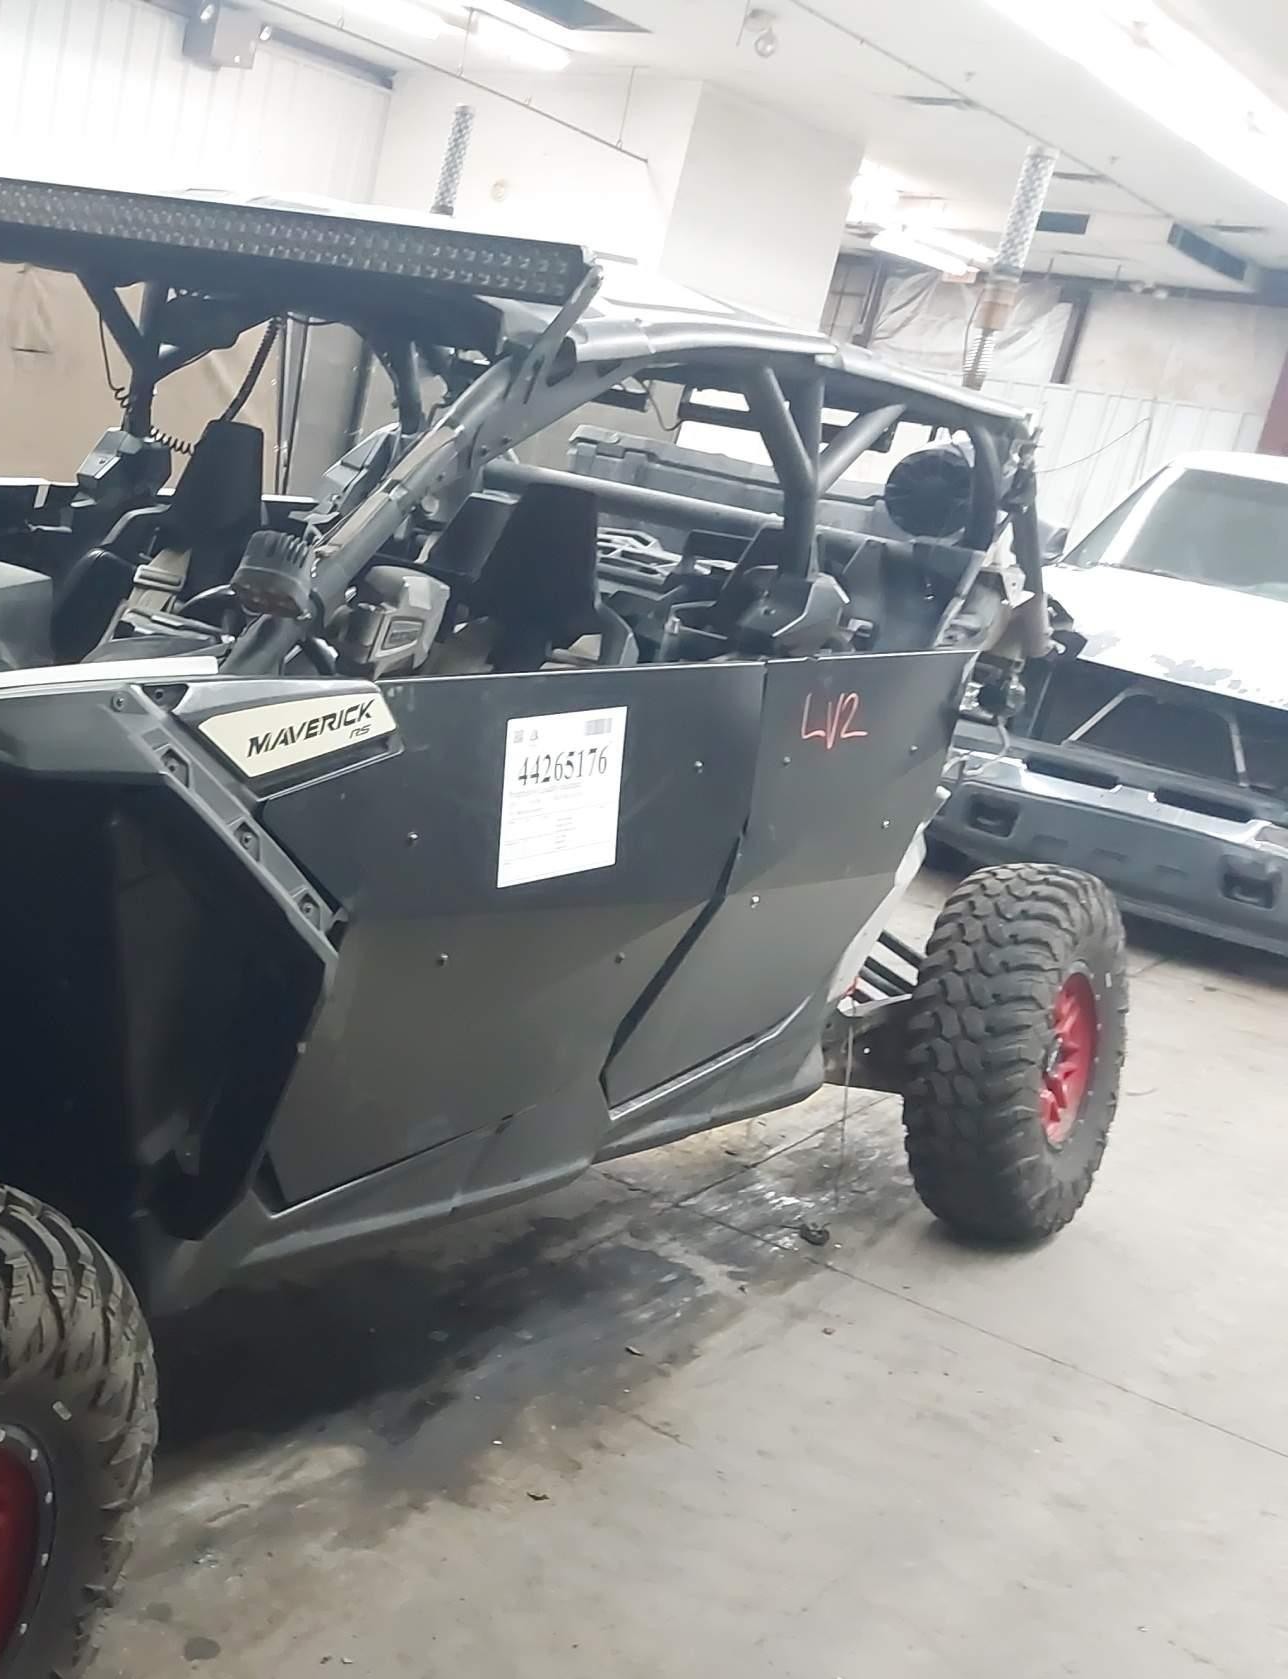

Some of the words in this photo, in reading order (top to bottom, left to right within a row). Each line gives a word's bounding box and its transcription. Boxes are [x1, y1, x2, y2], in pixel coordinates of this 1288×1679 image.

[247, 699, 376, 758] MAVERICK
[349, 723, 372, 739] RS
[518, 745, 609, 786] 44265176
